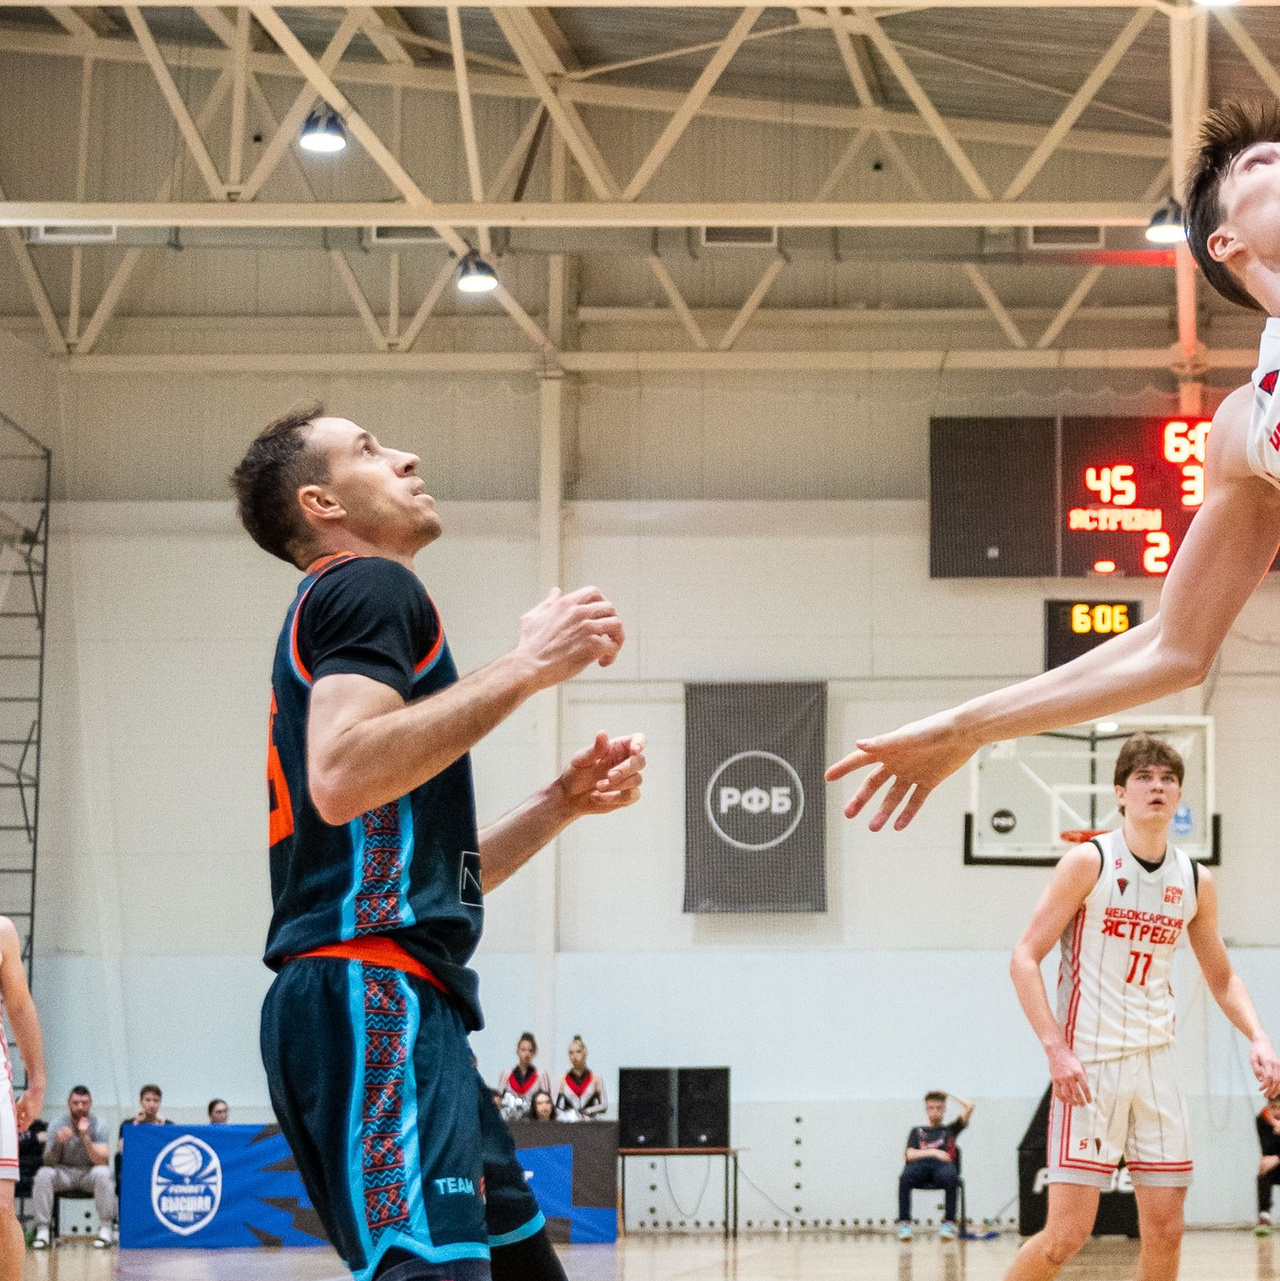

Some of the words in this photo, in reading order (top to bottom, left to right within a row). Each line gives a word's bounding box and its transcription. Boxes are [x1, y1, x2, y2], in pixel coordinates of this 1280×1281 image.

[1083, 464, 1138, 507] 45
[1142, 530, 1172, 574] 2
[719, 786, 792, 815] РФБ
[1163, 894, 1182, 904] BET
[1165, 885, 1184, 896] FON
[1105, 907, 1185, 930] ЧЕБОКСАРСКИЕ
[434, 1176, 476, 1196] TEAM
